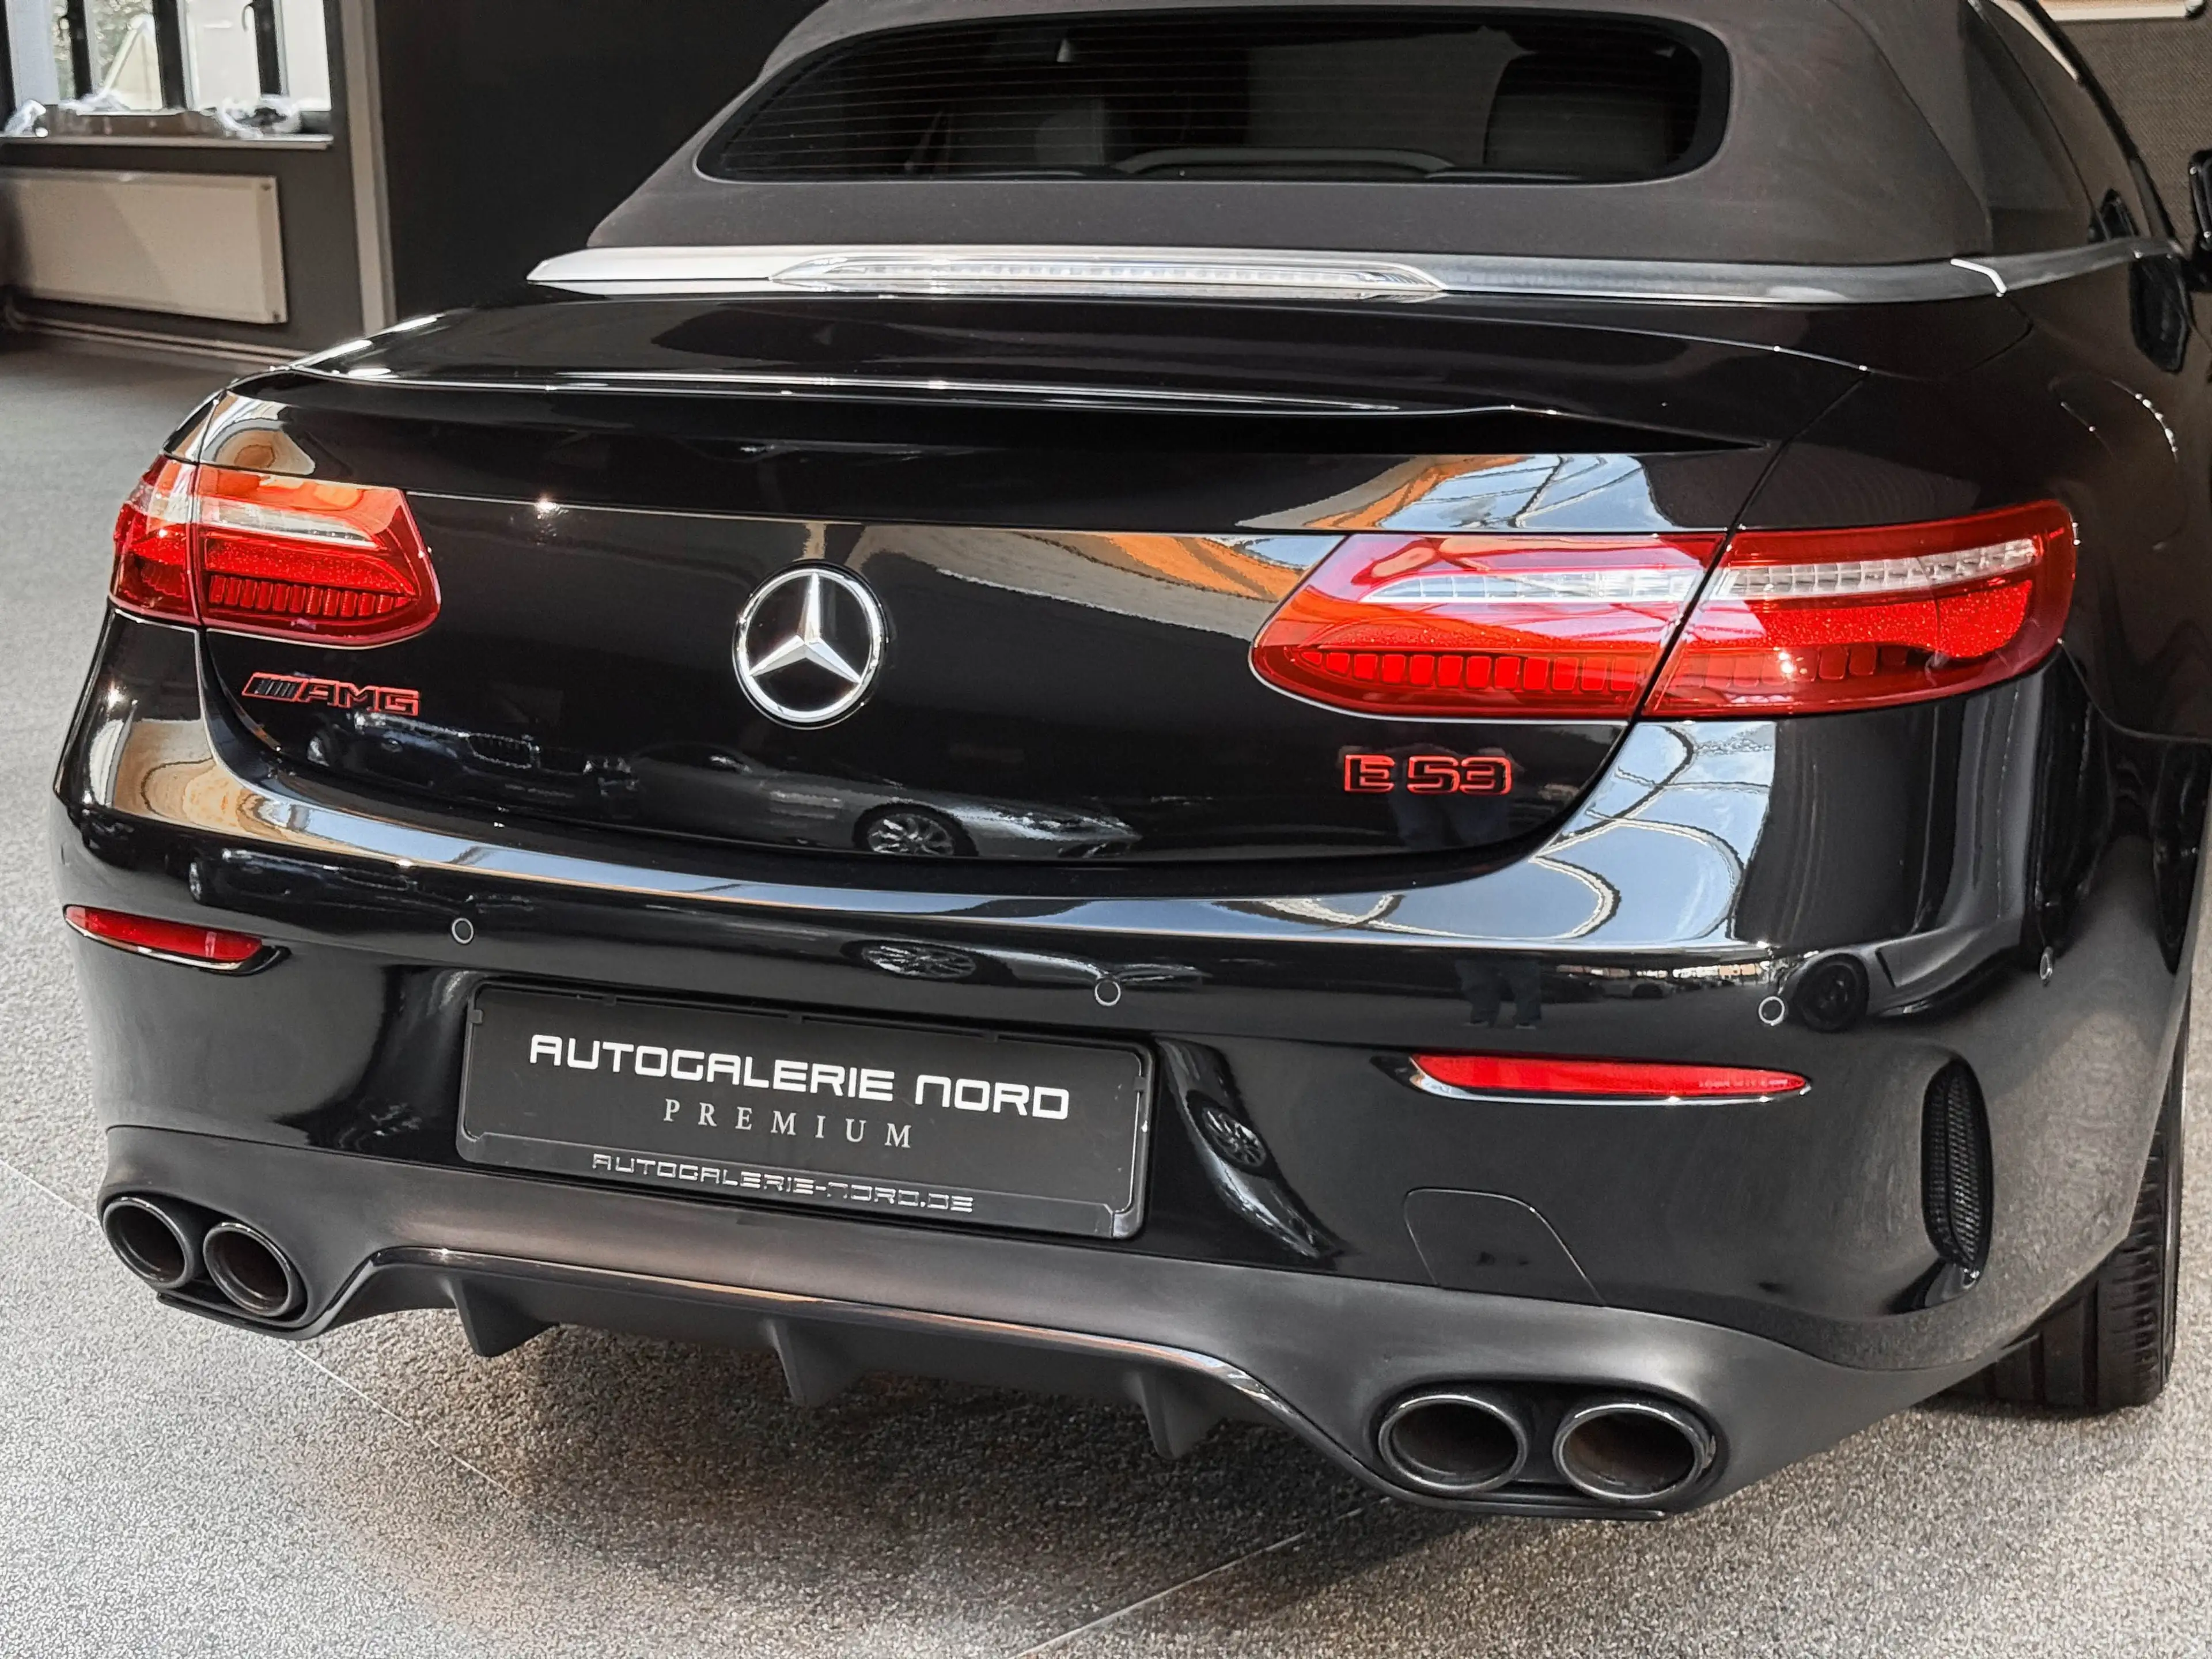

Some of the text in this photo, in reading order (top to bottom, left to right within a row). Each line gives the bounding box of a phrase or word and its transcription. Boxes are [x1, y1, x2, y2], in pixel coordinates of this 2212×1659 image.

[294, 677, 419, 717] AMG
[1344, 754, 1512, 795] E 53
[529, 1035, 1070, 1120] AUTOGALERIE NORD
[663, 1098, 912, 1149] PREMIUM
[592, 1153, 974, 1213] AUTOGALERIE-NORD.DE
